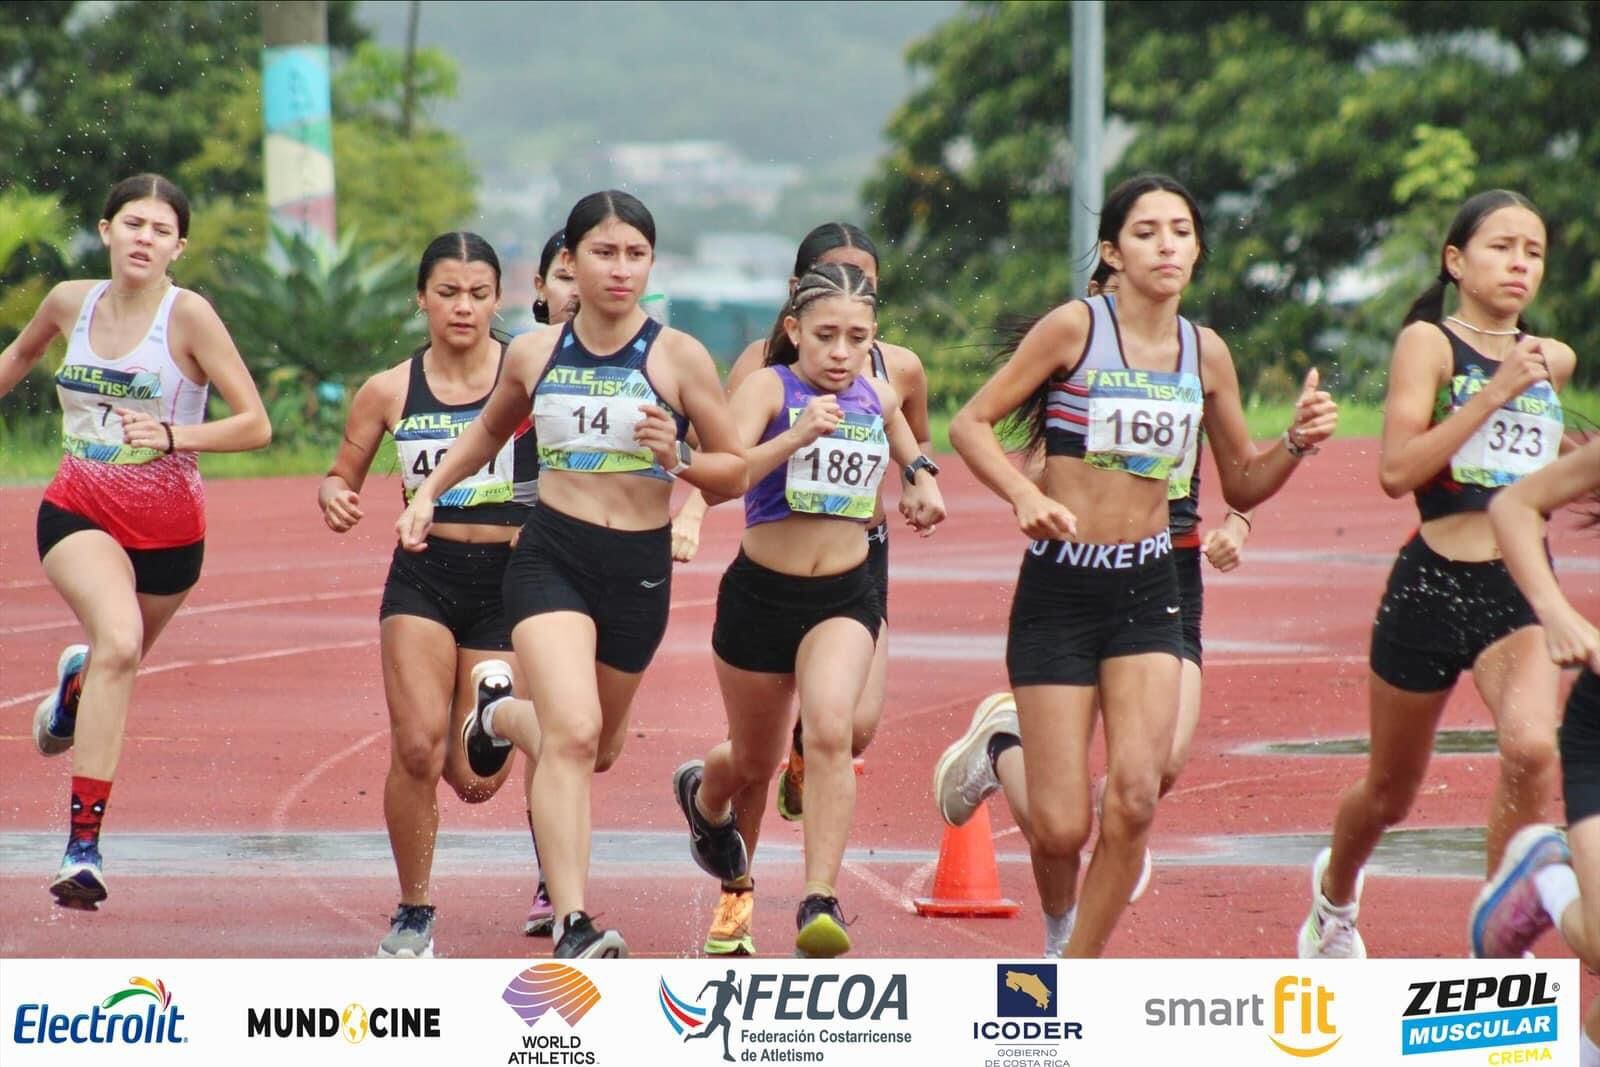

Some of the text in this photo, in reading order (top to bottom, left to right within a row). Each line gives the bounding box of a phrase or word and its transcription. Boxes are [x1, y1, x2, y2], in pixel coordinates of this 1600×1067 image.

[63, 366, 103, 383] ATLE
[545, 368, 595, 385] ATLE
[1099, 371, 1148, 388] ATLE
[98, 402, 112, 426] 7
[404, 413, 452, 432] ATLE
[572, 405, 610, 435] 14
[1106, 408, 1192, 449] 1681
[1488, 420, 1543, 457] 323
[804, 447, 882, 488] 1887
[1056, 540, 1134, 569] NIKE
